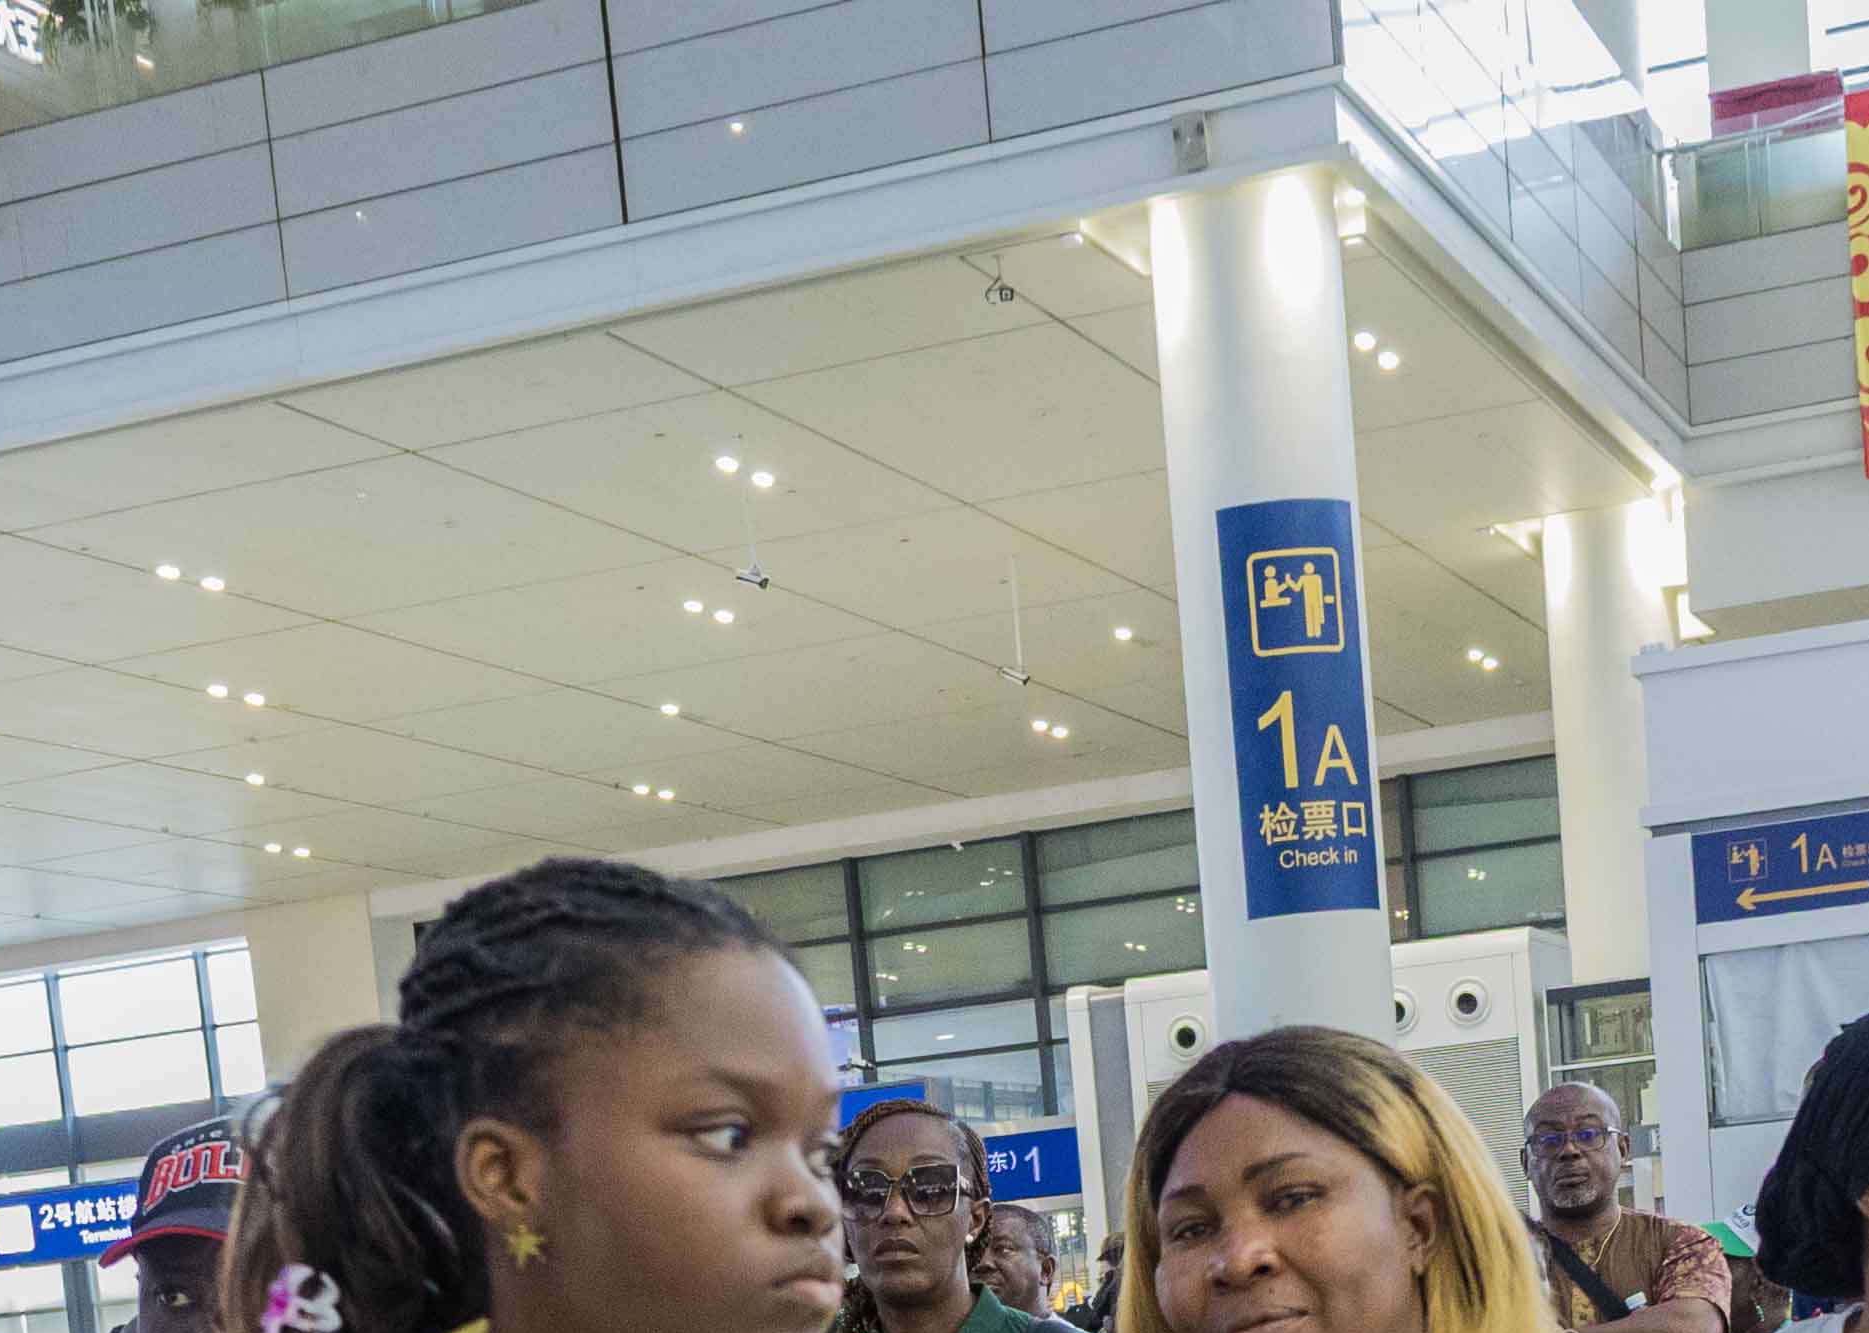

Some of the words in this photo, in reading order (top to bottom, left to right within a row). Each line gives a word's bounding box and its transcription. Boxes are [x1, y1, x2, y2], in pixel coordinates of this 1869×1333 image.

[1258, 690, 1359, 788] 1A
[1259, 800, 1368, 846] 检票口
[1279, 846, 1340, 868] Check
[1344, 849, 1359, 863] in
